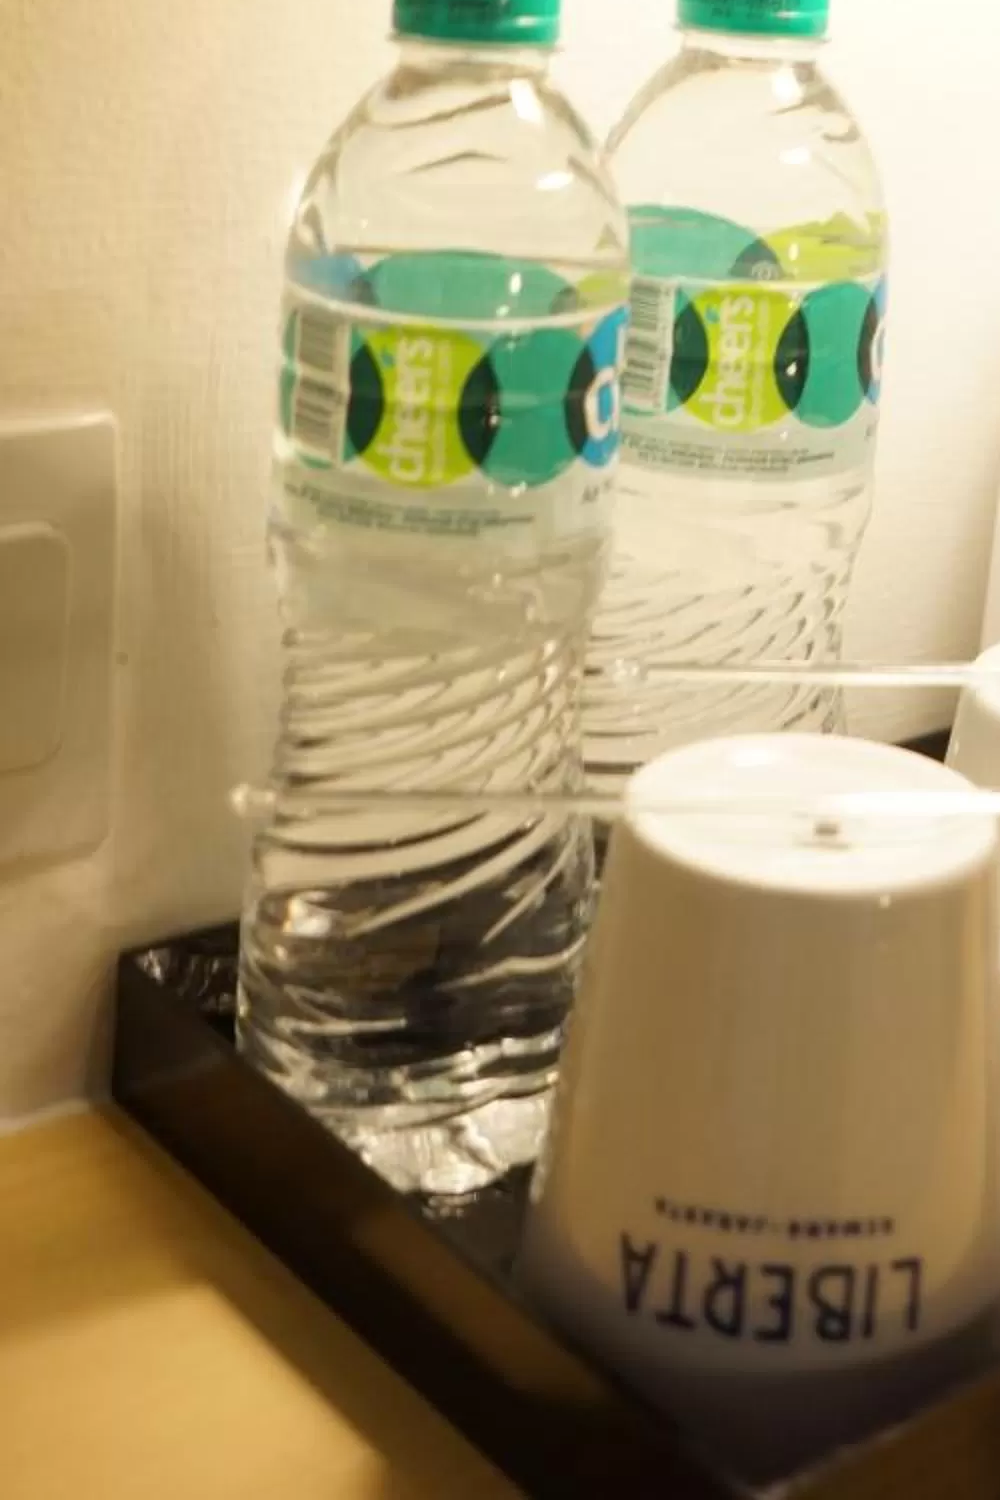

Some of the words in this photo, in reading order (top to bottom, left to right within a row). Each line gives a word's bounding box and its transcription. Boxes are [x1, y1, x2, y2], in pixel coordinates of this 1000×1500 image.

[376, 338, 433, 482] cheers
[700, 295, 755, 426] cheers
[619, 1231, 924, 1345] LIBERTA
